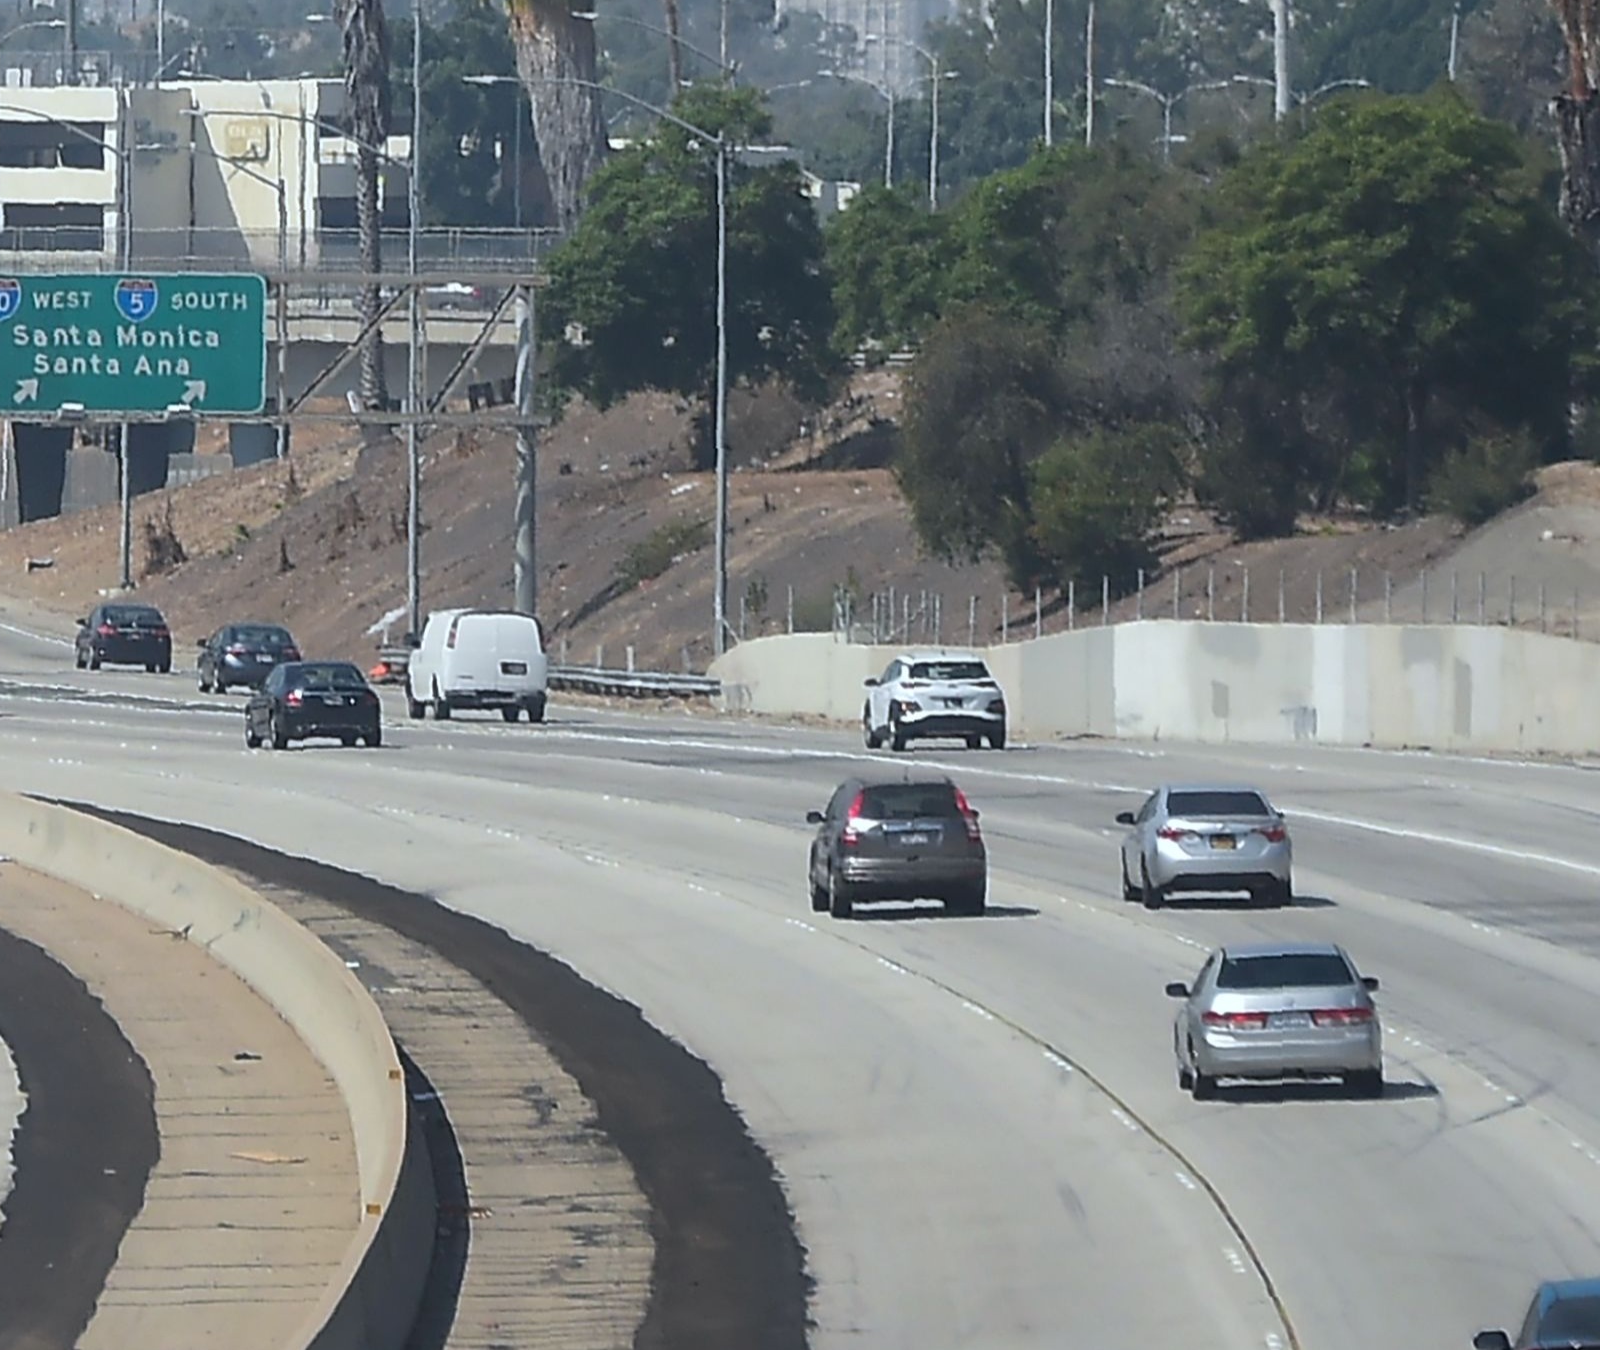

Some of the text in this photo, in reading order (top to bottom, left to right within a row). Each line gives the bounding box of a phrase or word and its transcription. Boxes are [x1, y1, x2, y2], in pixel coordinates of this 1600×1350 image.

[32, 291, 92, 309] WEST
[129, 293, 144, 314] 5
[171, 292, 248, 310] SOUTH
[13, 325, 220, 347] Santa Monica
[34, 354, 191, 376] Santa Ana
